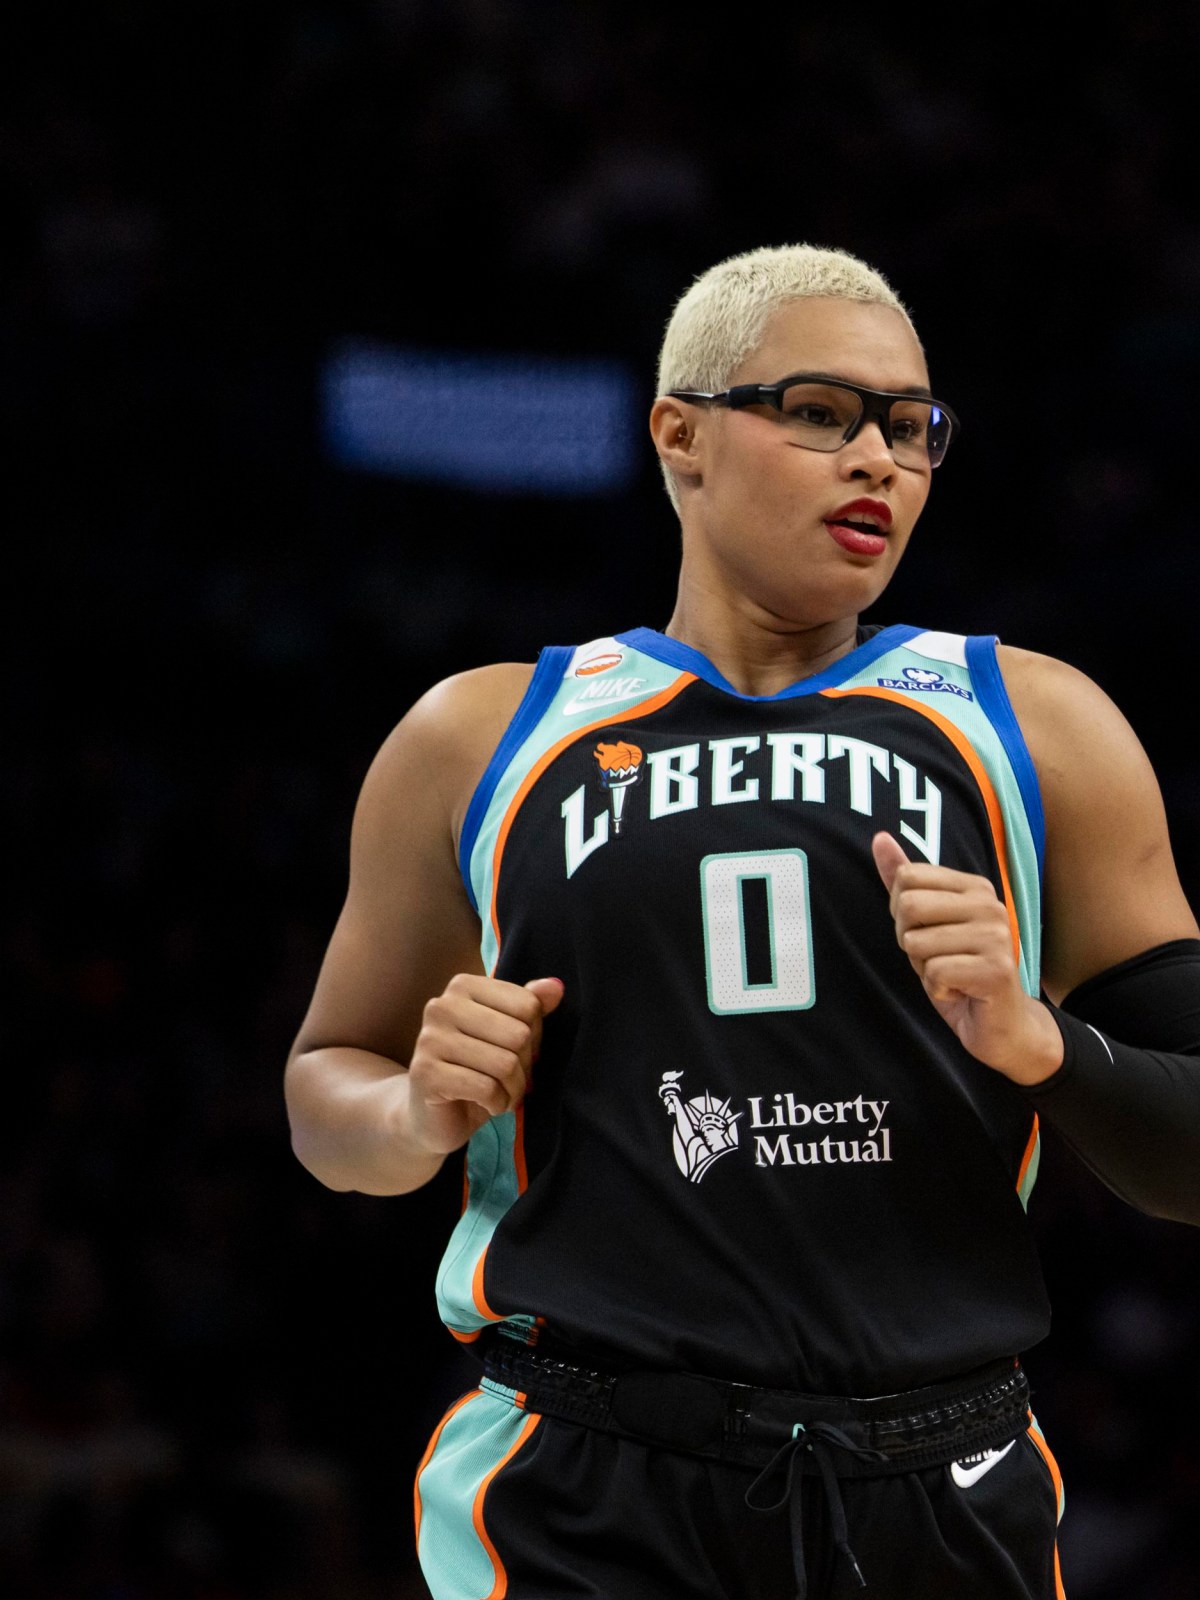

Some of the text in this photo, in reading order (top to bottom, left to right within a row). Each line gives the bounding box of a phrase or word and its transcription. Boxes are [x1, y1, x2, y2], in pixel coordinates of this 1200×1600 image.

[580, 677, 646, 700] NIKE
[883, 680, 970, 699] BARCLAYS
[700, 848, 816, 1016] 0
[747, 1092, 890, 1137] Liberty
[753, 1128, 893, 1168] Mutual
